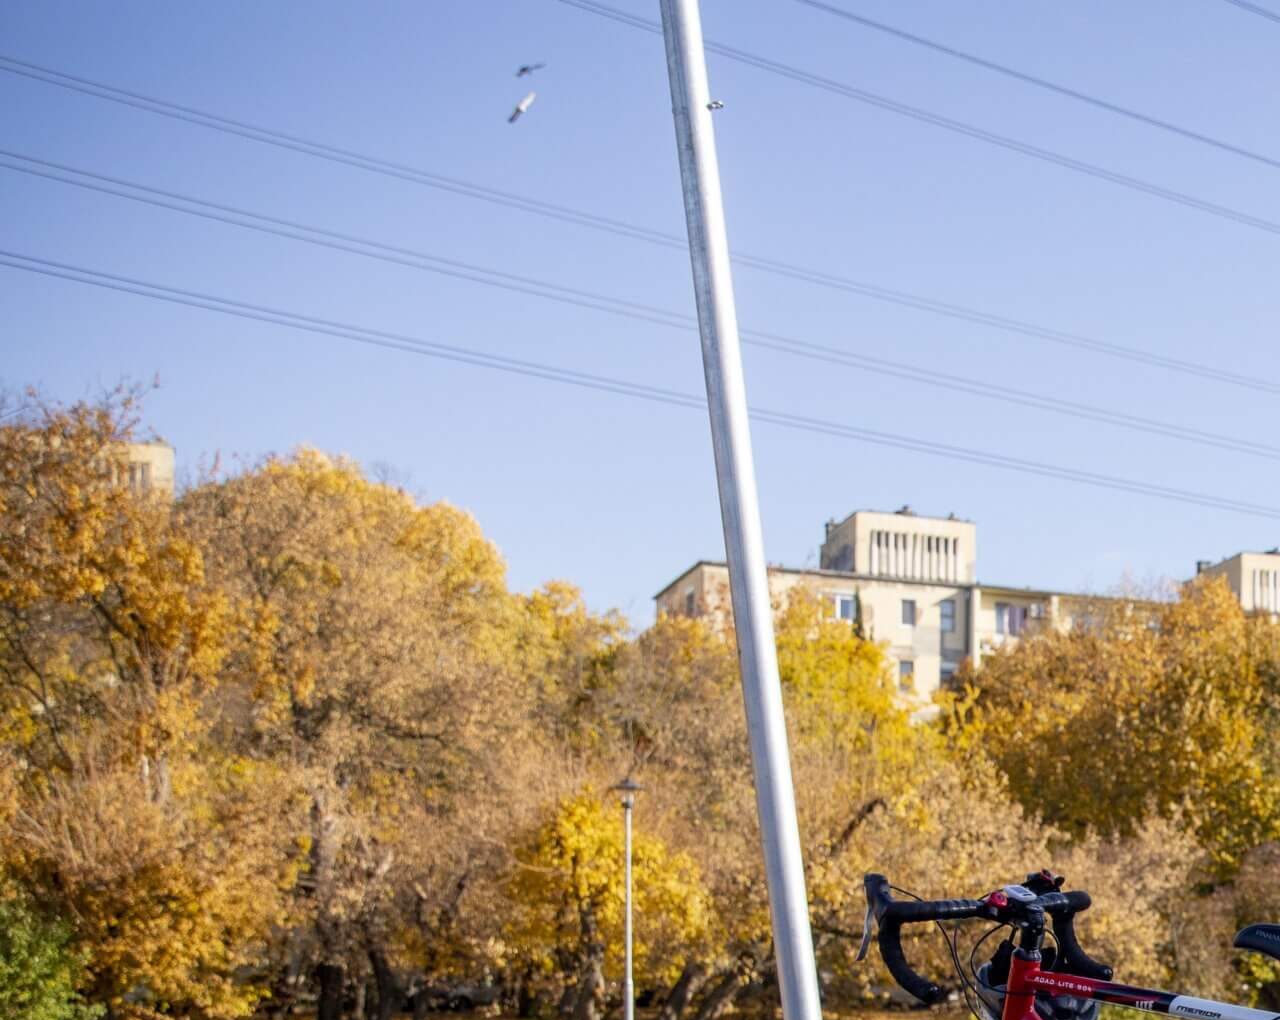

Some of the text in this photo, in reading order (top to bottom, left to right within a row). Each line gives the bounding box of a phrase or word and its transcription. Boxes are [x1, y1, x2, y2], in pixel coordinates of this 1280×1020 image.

[1034, 976, 1055, 985] ROAD
[1058, 981, 1074, 989] LITE
[1176, 1004, 1222, 1019] MERIDA
